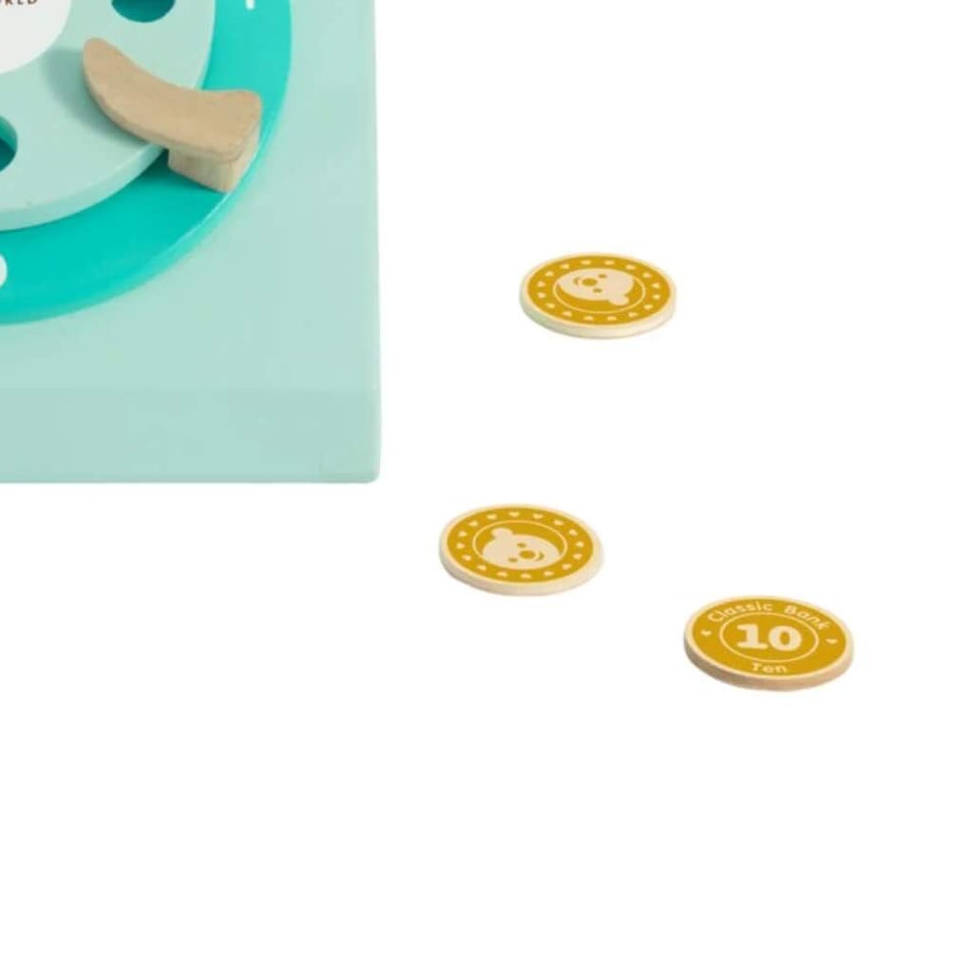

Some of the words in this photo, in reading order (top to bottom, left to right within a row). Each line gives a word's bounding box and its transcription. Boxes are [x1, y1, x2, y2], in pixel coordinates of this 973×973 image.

[707, 601, 773, 623] Classic
[784, 604, 830, 630] Bank
[736, 623, 802, 652] 10
[752, 662, 788, 673] Ten
